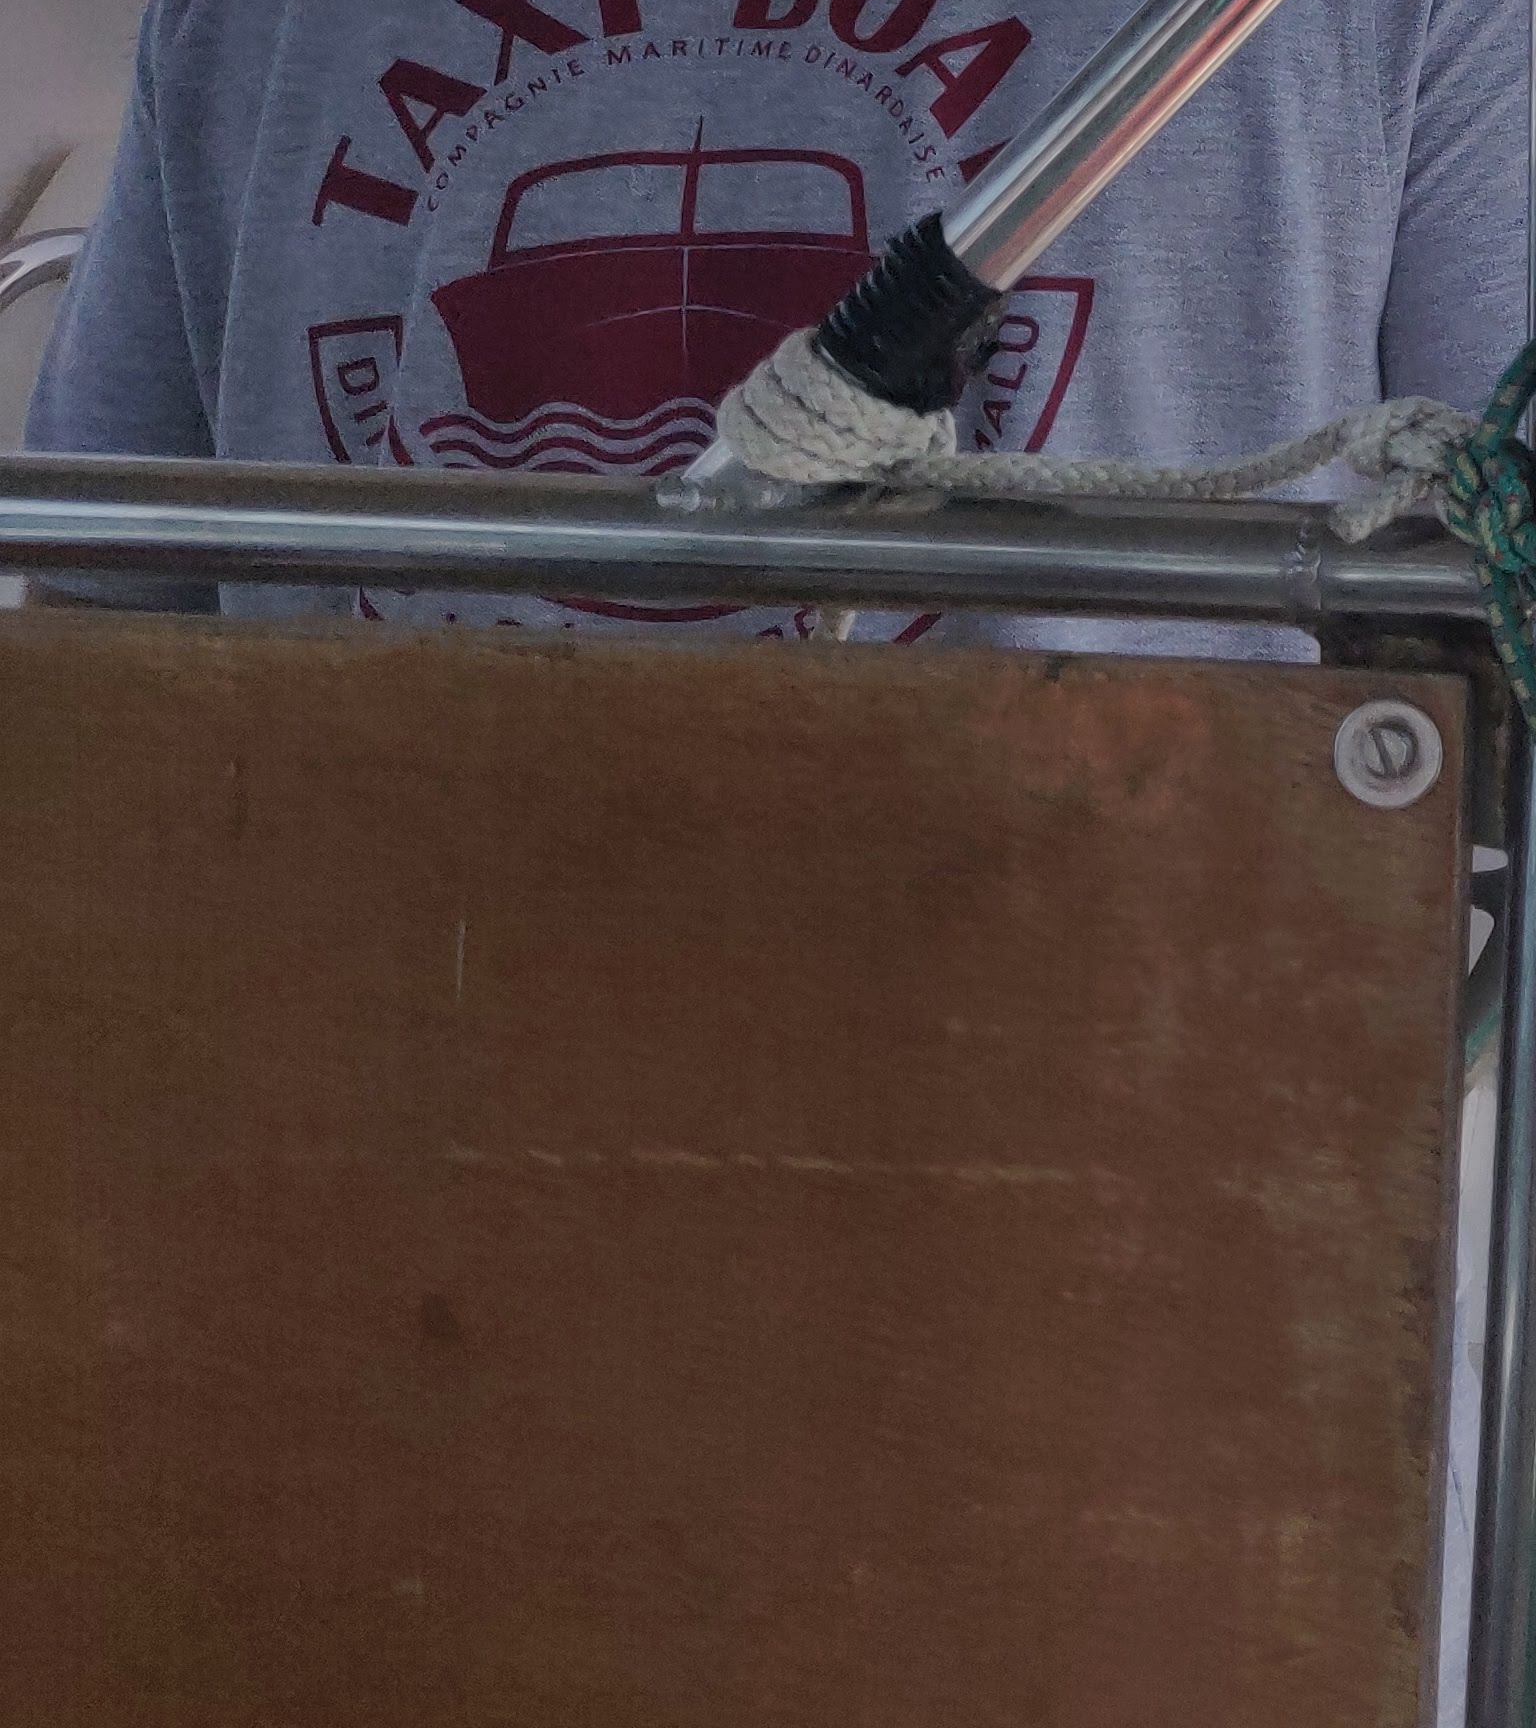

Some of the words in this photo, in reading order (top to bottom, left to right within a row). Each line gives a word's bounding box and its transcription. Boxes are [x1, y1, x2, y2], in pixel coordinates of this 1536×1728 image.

[427, 58, 586, 213] COMPAGNIE
[607, 36, 793, 67] MARITIME
[804, 43, 947, 184] DINARDAISE
